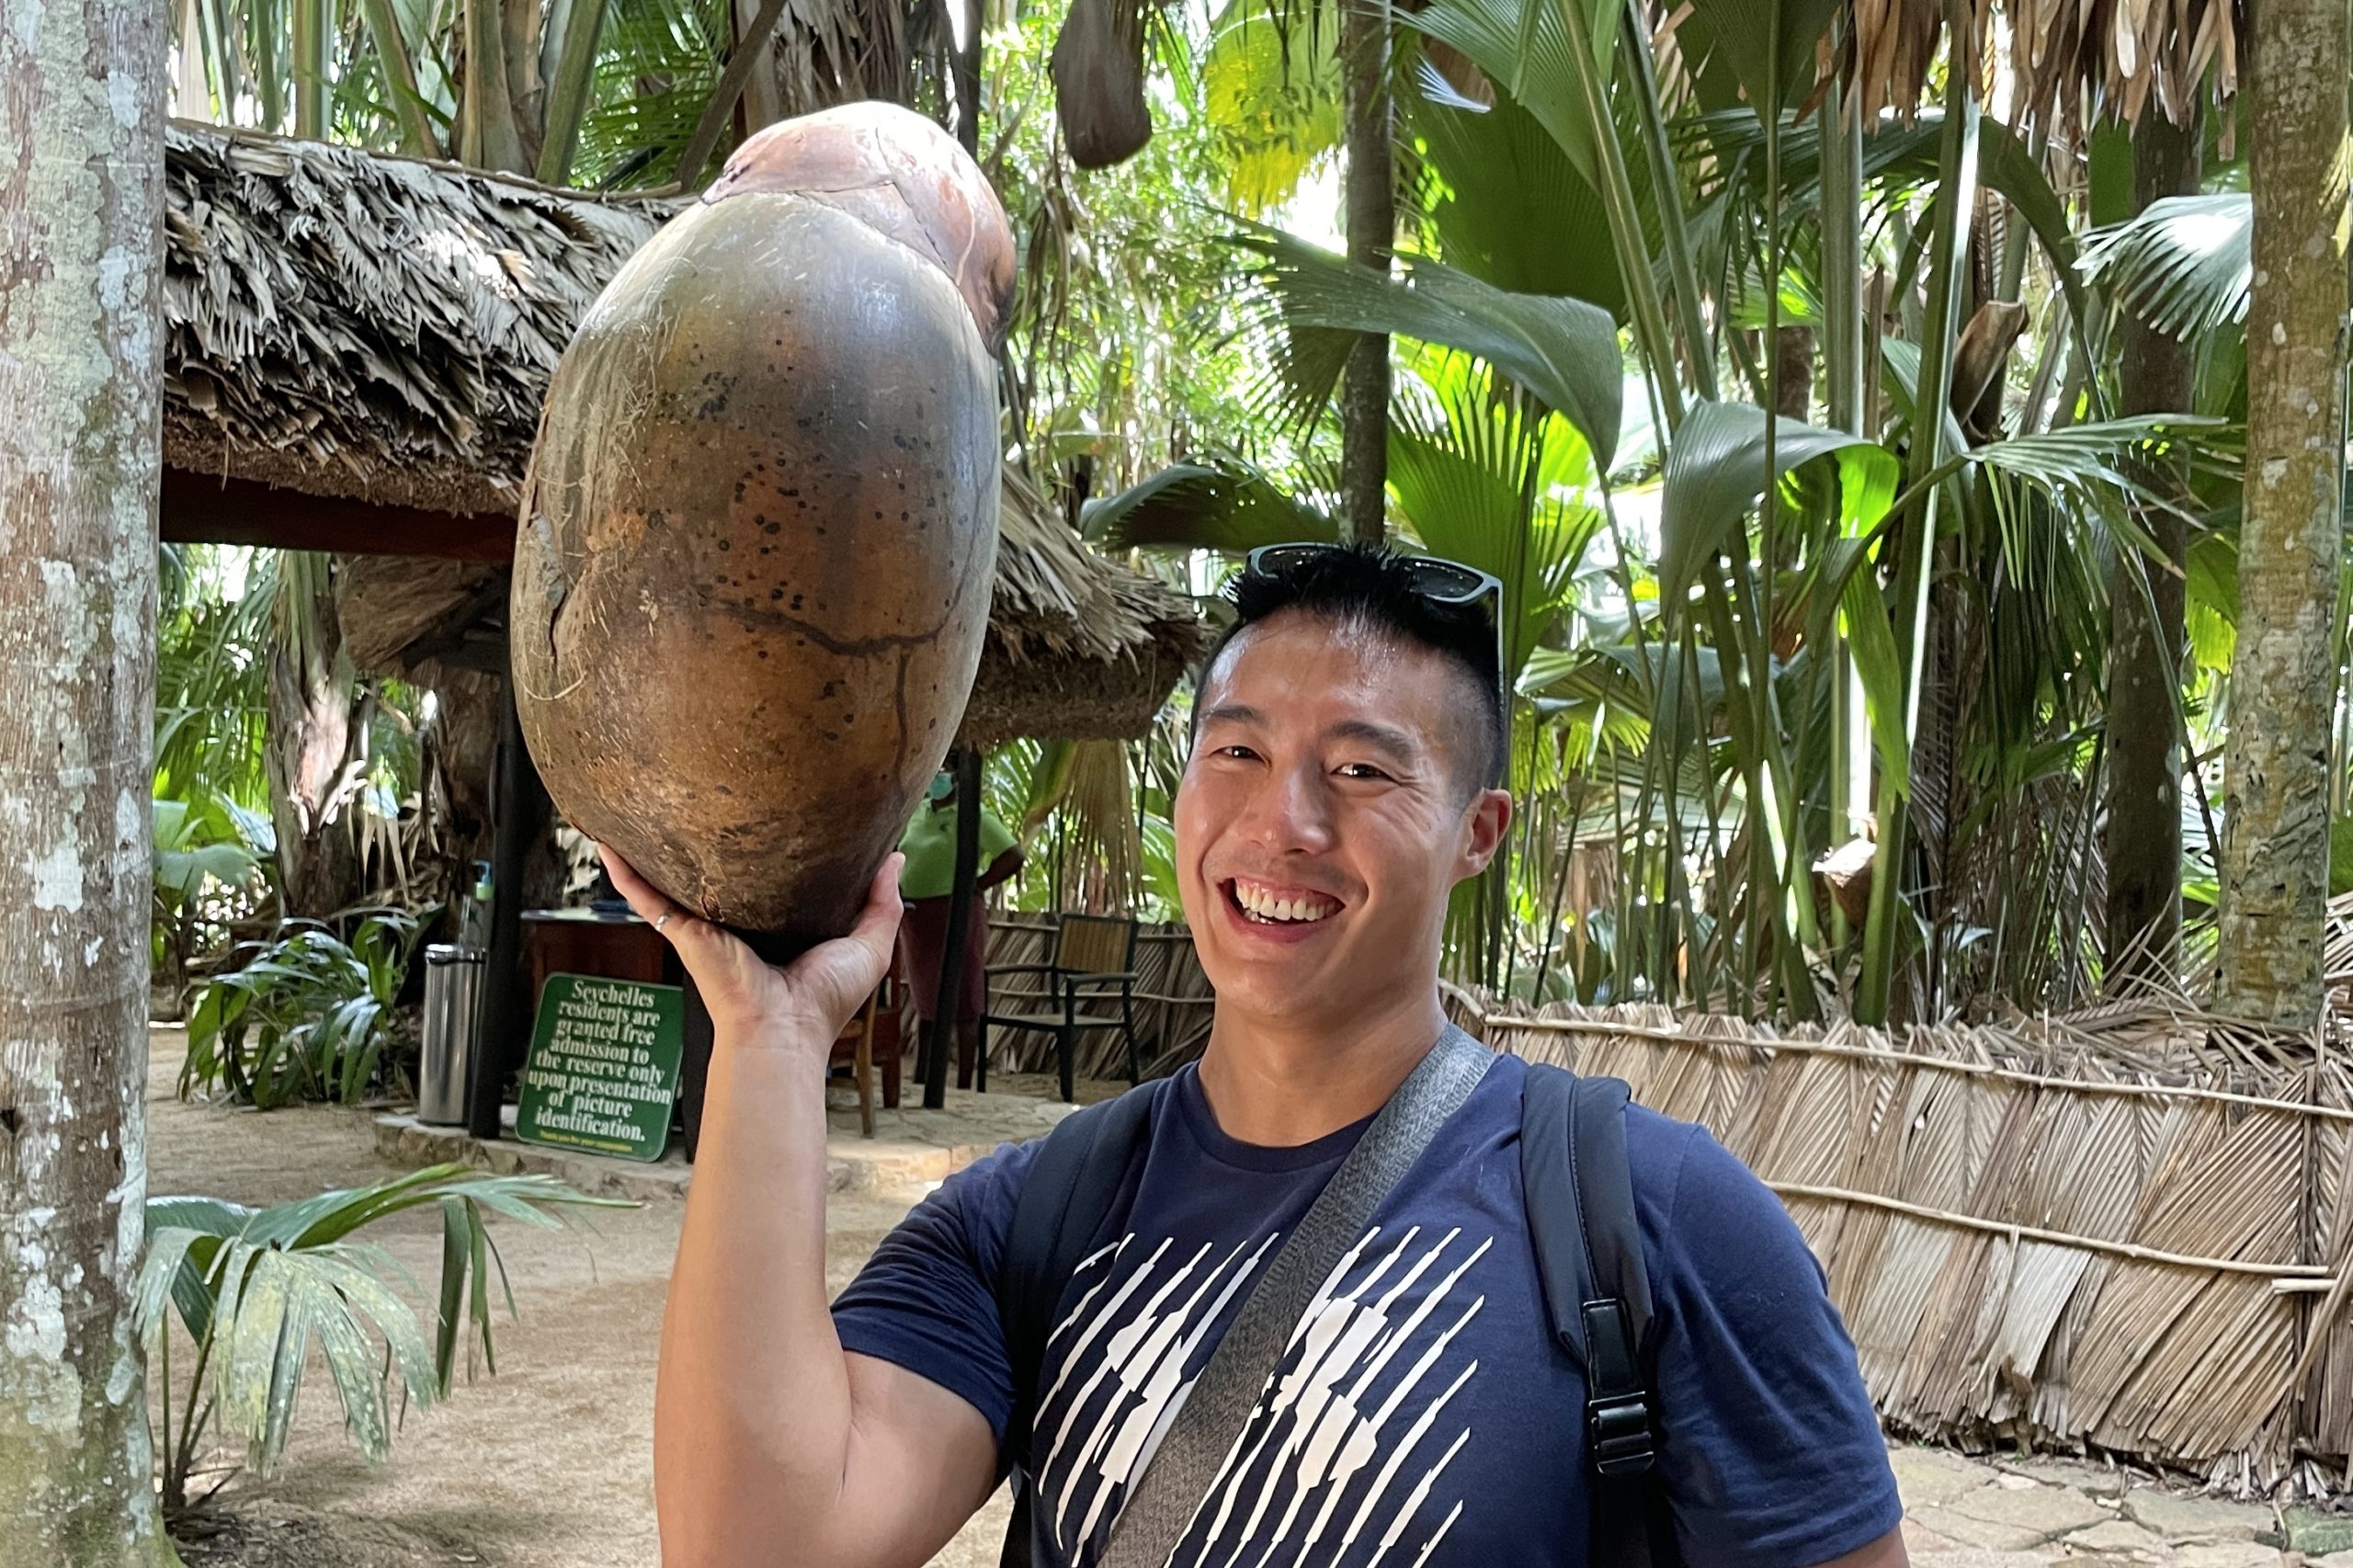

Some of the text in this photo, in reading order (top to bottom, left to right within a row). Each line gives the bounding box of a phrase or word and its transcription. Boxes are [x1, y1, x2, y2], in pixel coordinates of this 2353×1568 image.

[573, 980, 654, 1007] Seychelles
[559, 1001, 660, 1027] residents are
[556, 1019, 655, 1046] granted free
[551, 1038, 650, 1065] admission to
[537, 1050, 665, 1085] the reserve only
[529, 1071, 671, 1105] upon presentation
[549, 1089, 633, 1118] of picture
[535, 1106, 645, 1142] identification.
